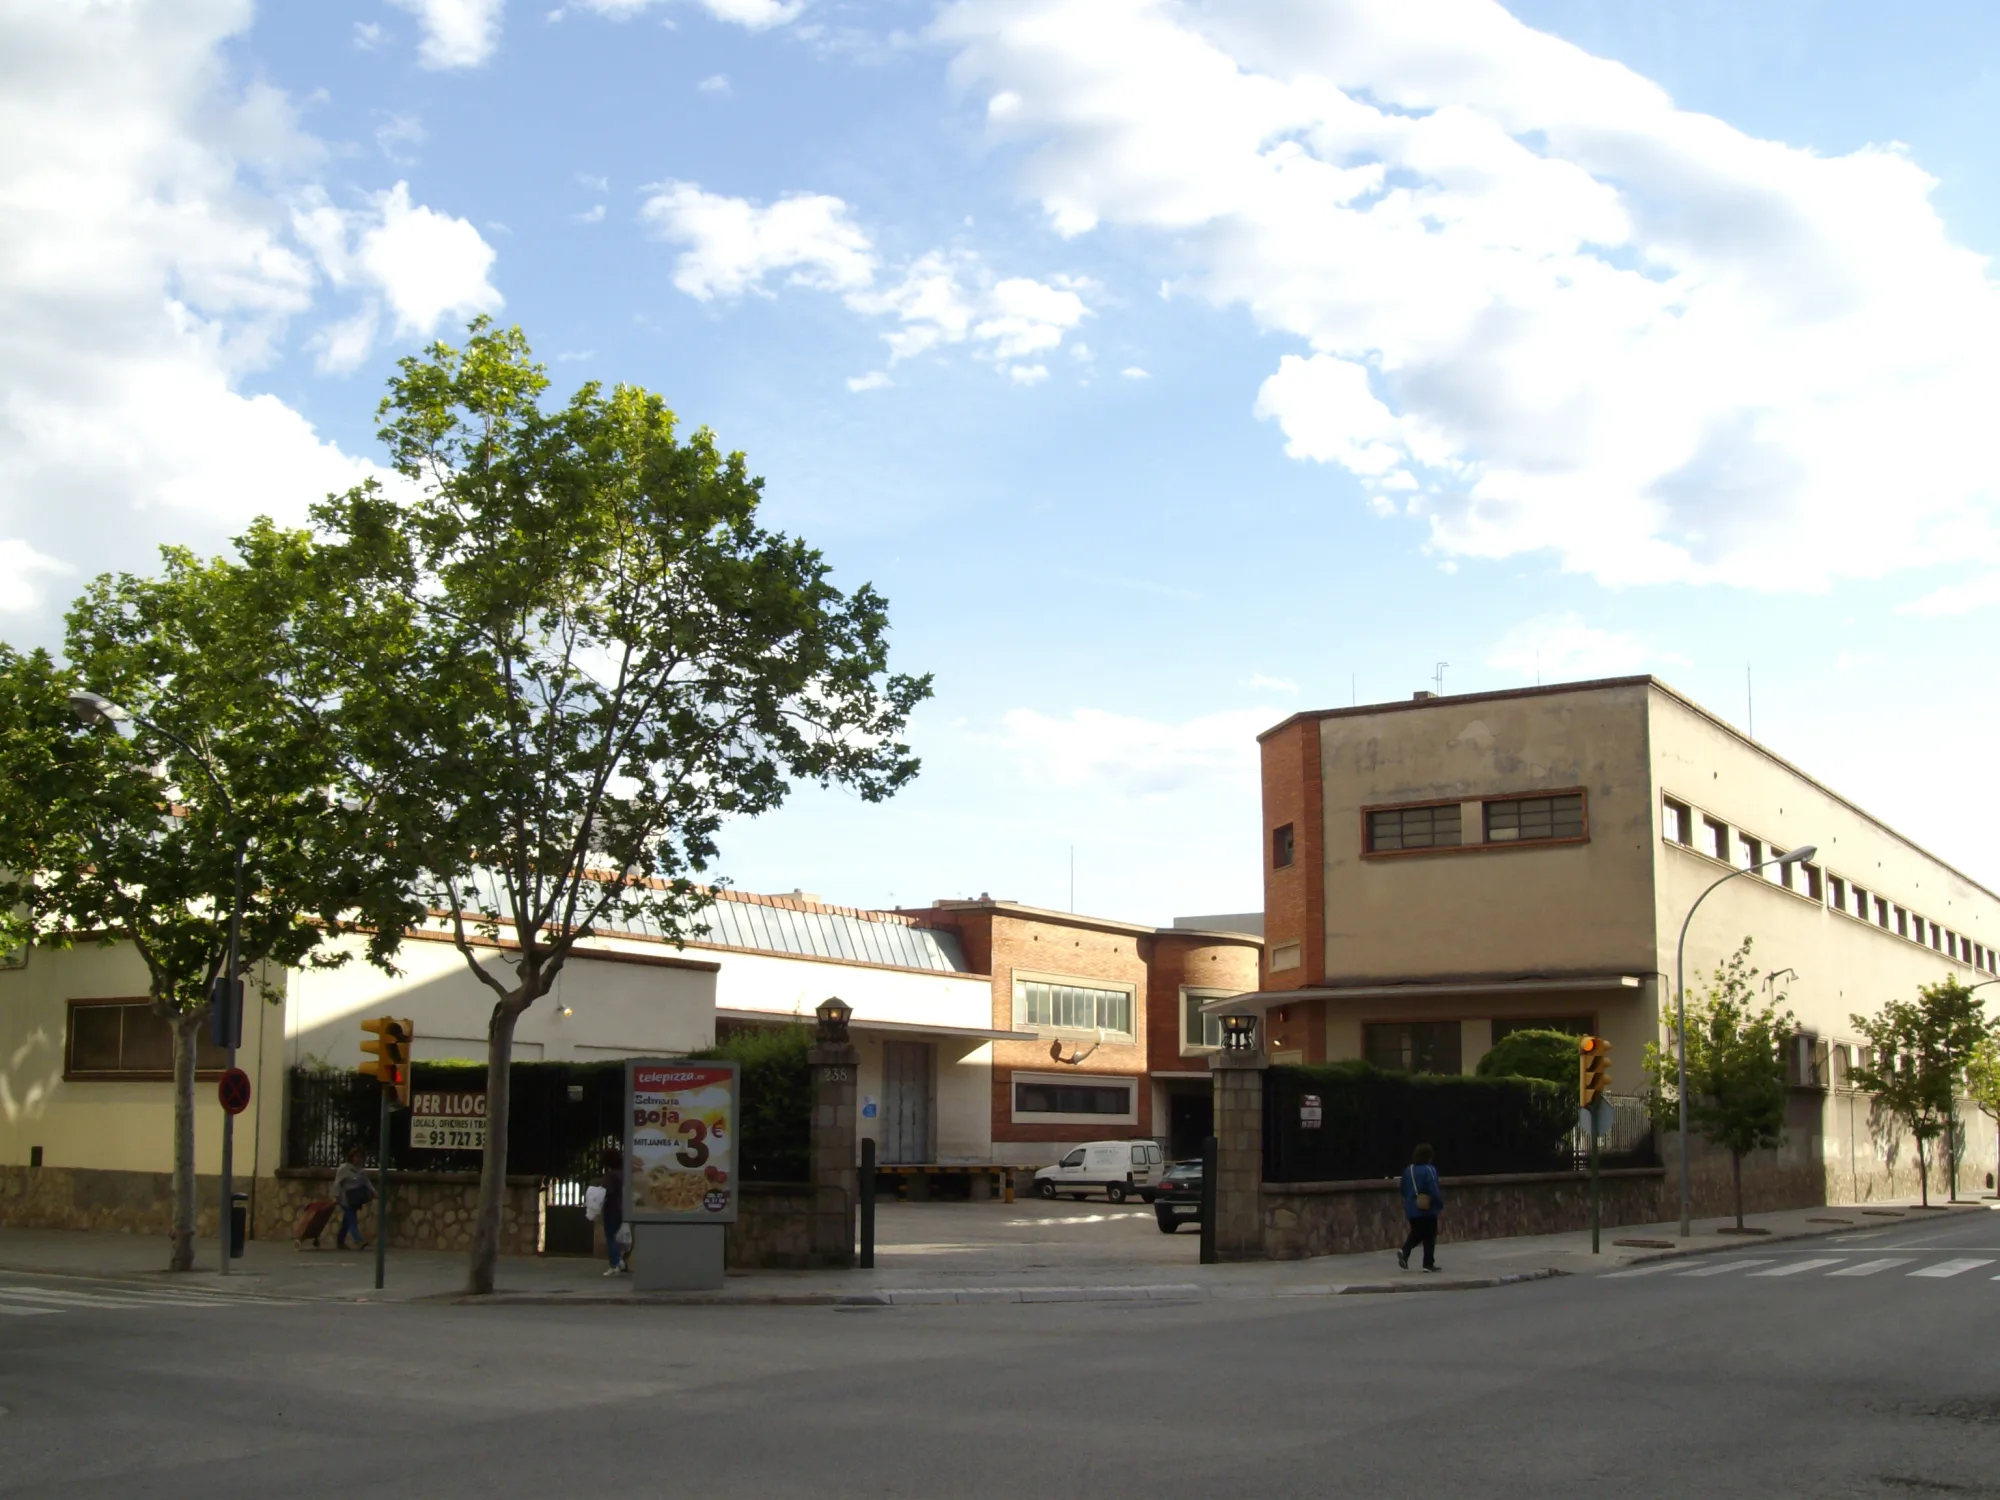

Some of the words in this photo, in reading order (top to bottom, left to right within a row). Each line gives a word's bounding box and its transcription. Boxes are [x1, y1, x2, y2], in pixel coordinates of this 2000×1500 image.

[638, 1071, 705, 1085] telepizza.es
[824, 1067, 848, 1081] 238
[413, 1094, 441, 1113] PER
[445, 1094, 486, 1115] LLOG
[635, 1094, 680, 1105] Setmana
[413, 1117, 438, 1129] LOCALS,
[439, 1119, 469, 1128] OFICINES
[634, 1106, 680, 1127] Boja
[429, 1130, 446, 1146] 93
[449, 1131, 471, 1146] 727
[634, 1138, 672, 1147] MITJANES
[673, 1139, 680, 1147] A
[675, 1118, 709, 1169] 3
[711, 1115, 726, 1138] €
